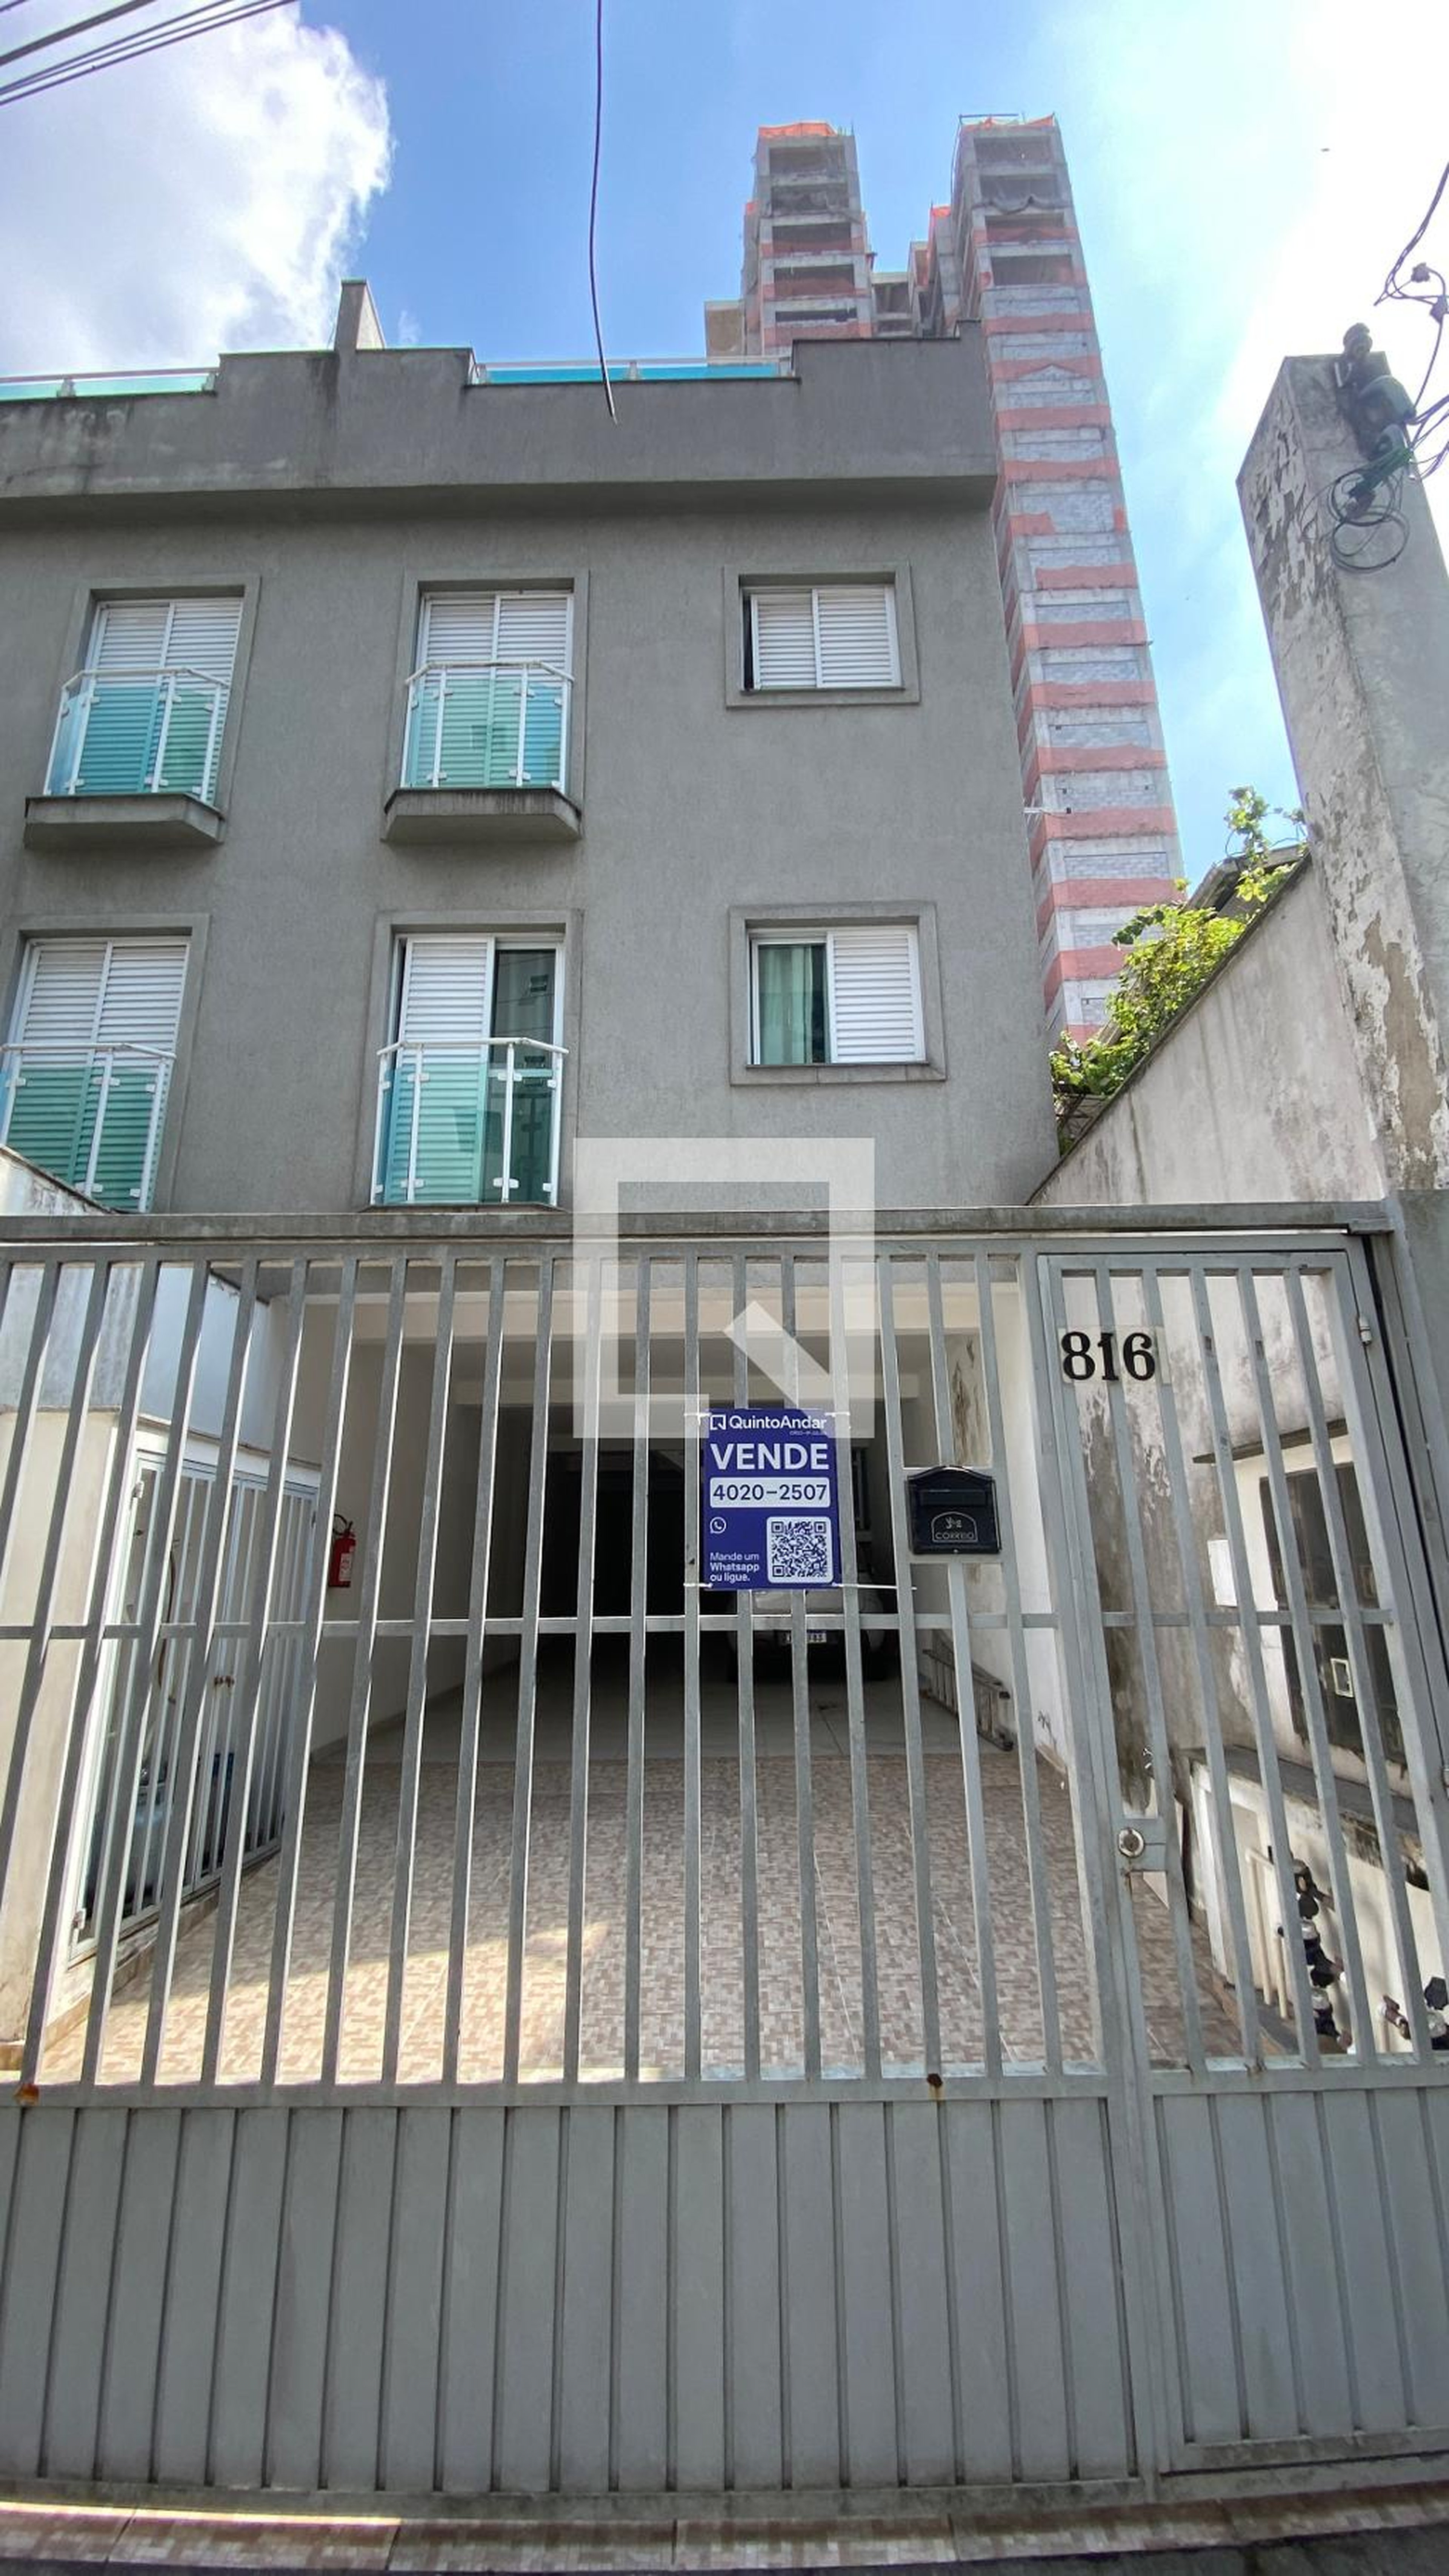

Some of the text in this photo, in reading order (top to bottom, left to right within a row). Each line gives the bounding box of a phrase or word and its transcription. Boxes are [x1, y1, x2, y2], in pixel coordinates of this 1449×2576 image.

[1061, 1331, 1155, 1381] 816
[729, 1415, 827, 1429] QuintoAndar
[710, 1443, 829, 1470] VENDE
[712, 1484, 828, 1501] 4020-2507
[710, 1552, 743, 1561] Mande
[710, 1563, 759, 1573] Whatsapp
[724, 1572, 751, 1584] ligue.
